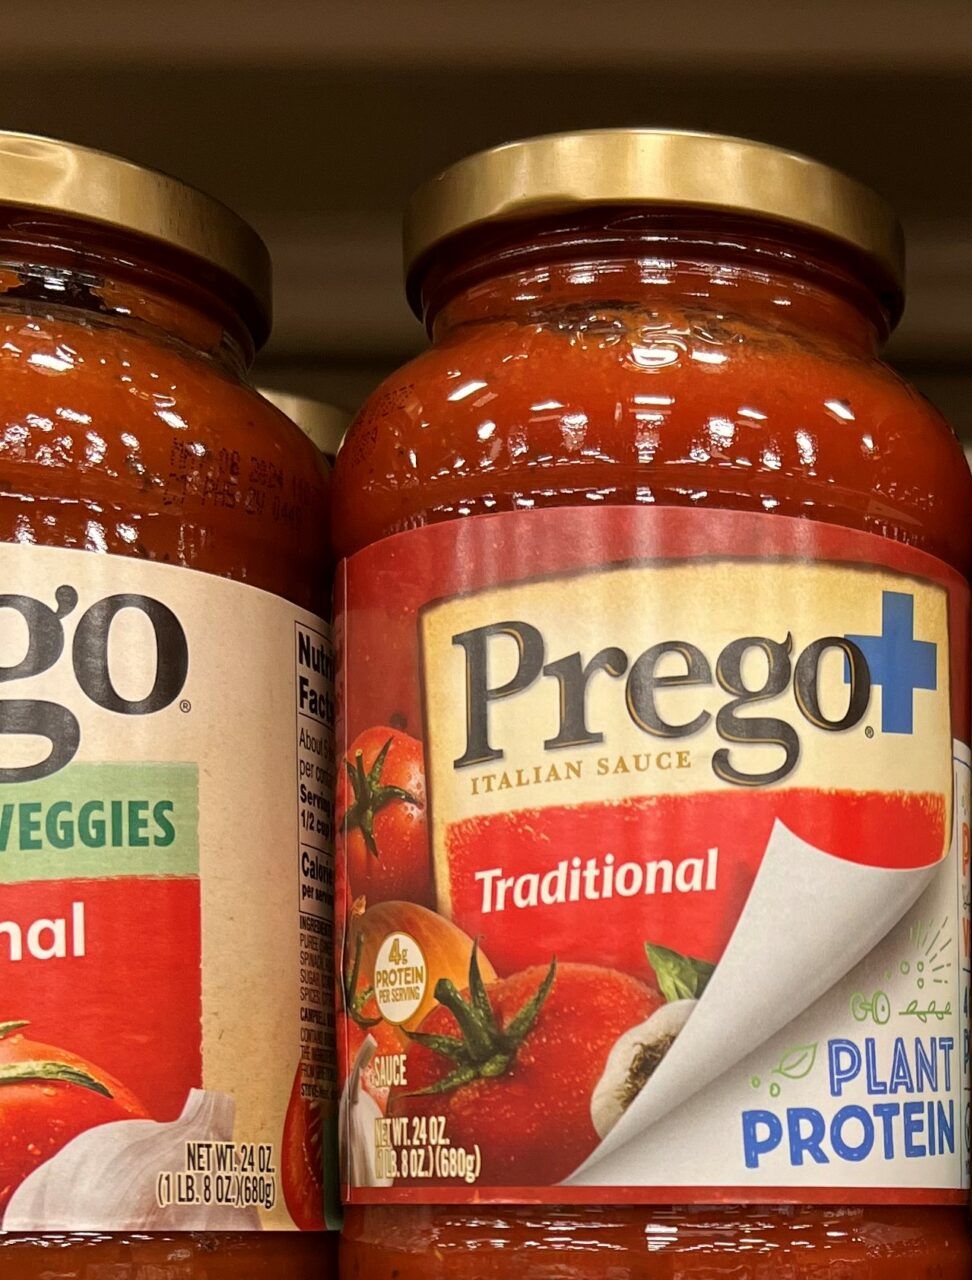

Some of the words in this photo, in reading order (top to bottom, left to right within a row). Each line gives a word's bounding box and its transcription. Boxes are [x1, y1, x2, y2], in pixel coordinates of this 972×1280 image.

[470, 759, 583, 796] ITALIAN
[596, 751, 692, 777] SAUCE
[474, 848, 719, 914] Traditional
[375, 966, 424, 988] PROTEIN
[374, 1055, 407, 1087] SAUCE
[828, 1036, 955, 1098] PLANT
[413, 1117, 428, 1146] 24
[430, 1116, 450, 1146] OZ.
[741, 1100, 957, 1170] PROTEIN
[187, 1143, 212, 1171] NET
[215, 1144, 237, 1172] WT.
[241, 1145, 254, 1172] 24
[259, 1145, 275, 1173] OZ.
[158, 1174, 170, 1205] (1
[178, 1175, 199, 1203] LB.
[204, 1175, 211, 1203] 8
